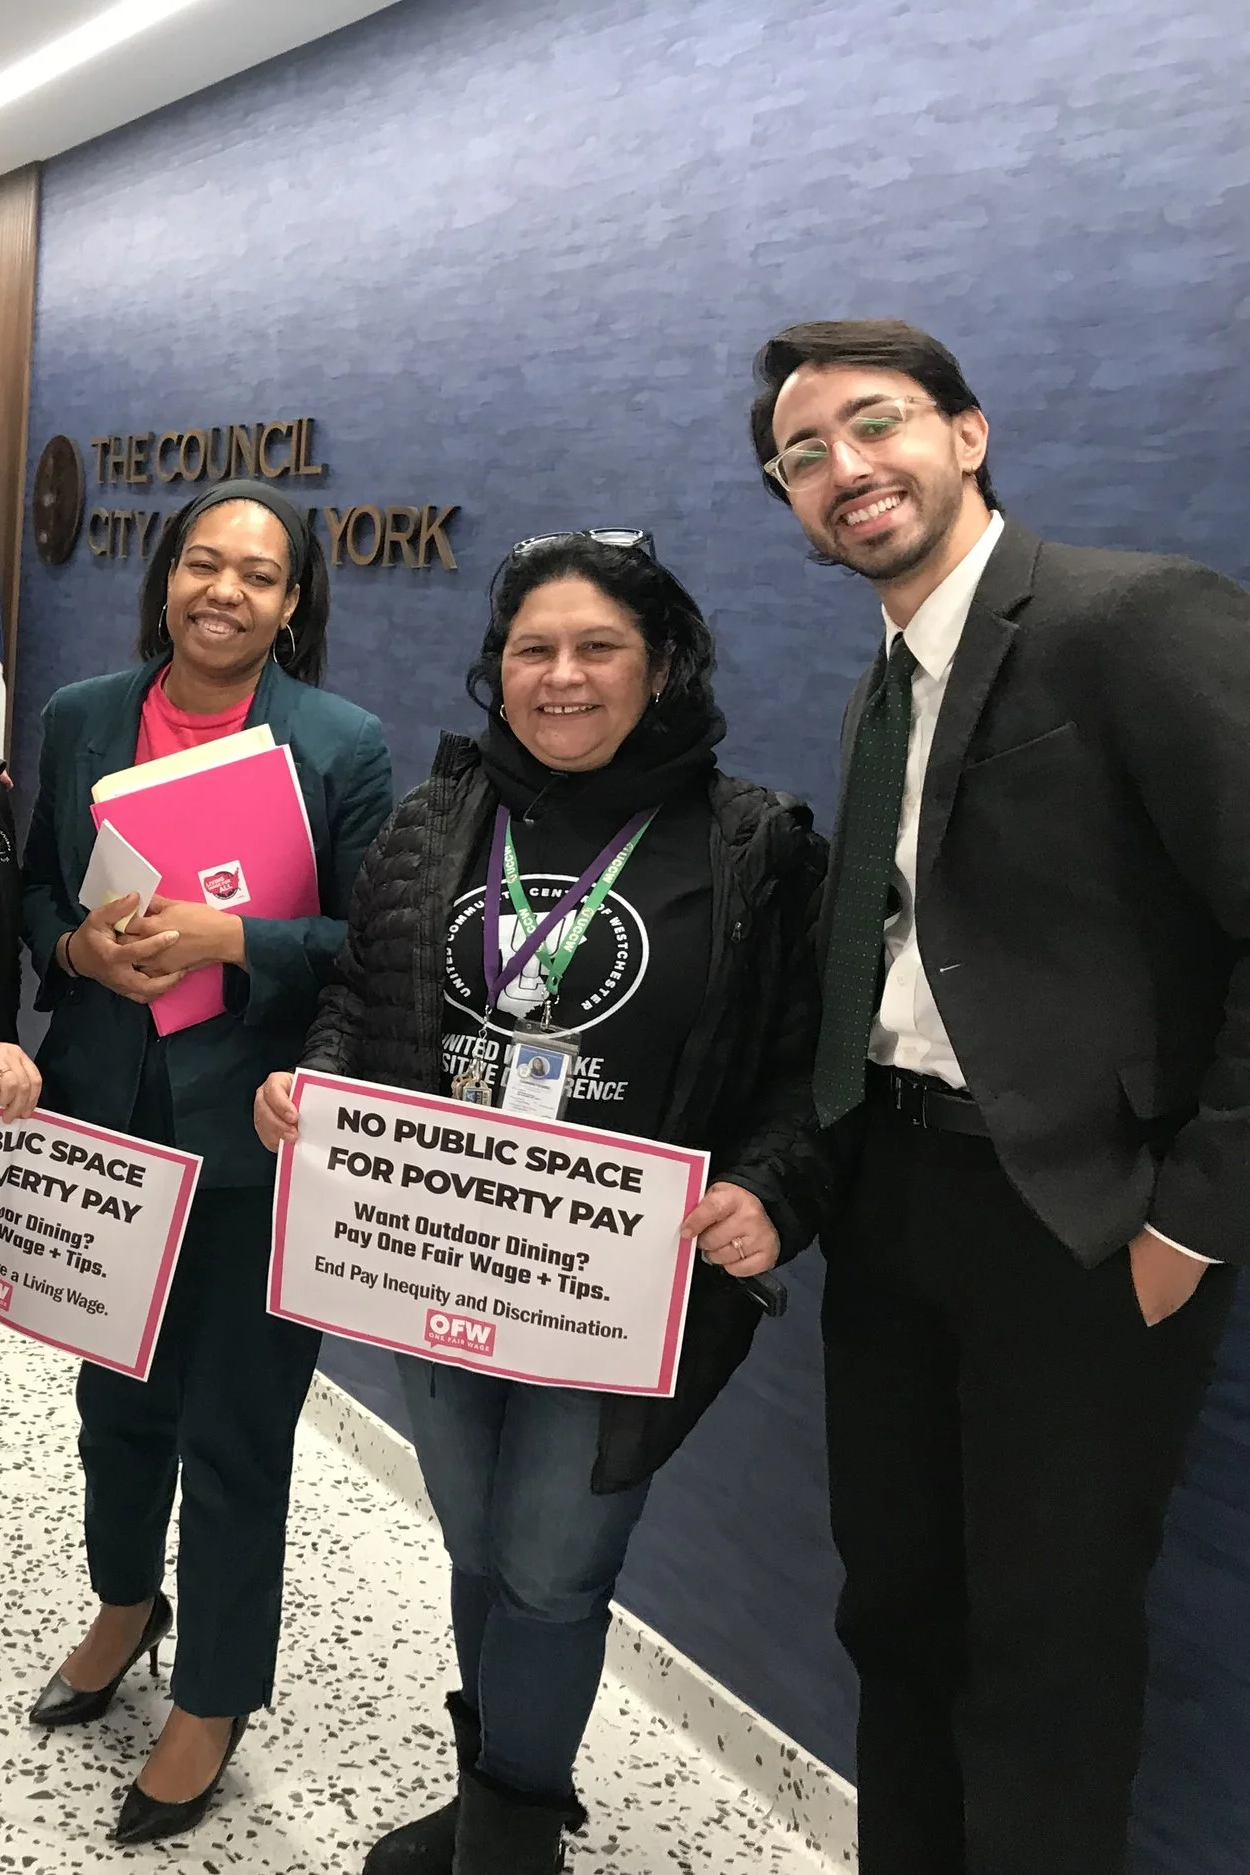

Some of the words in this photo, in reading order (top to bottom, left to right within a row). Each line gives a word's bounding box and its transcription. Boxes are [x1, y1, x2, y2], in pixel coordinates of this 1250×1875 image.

[90, 434, 151, 484] THE
[155, 417, 326, 484] COUNCIL
[86, 508, 153, 560] CITY
[324, 504, 459, 571] YORK
[580, 917, 629, 1011] WESTCHESTER
[49, 1139, 147, 1189] SPACE
[337, 1106, 386, 1138] NO
[394, 1118, 519, 1166] PUBLIC
[524, 1146, 644, 1194] SPACE
[81, 1187, 143, 1225] PAY
[327, 1146, 395, 1184] FOR
[400, 1163, 564, 1219] POVERTY
[569, 1199, 645, 1238] PAY
[25, 1213, 95, 1250] Dining?
[49, 1247, 62, 1259] +
[66, 1249, 108, 1278] Tips.
[333, 1220, 372, 1250] Pay
[377, 1232, 417, 1258] One
[421, 1243, 464, 1269] Fair
[469, 1252, 532, 1286] Wage
[536, 1272, 552, 1286] +
[557, 1272, 611, 1302] Tips.
[354, 1202, 410, 1231] Want
[415, 1216, 501, 1251] Outdoor
[505, 1236, 590, 1273] Dining?
[10, 1271, 20, 1283] a
[22, 1272, 64, 1303] Living
[66, 1290, 109, 1316] Wage.
[314, 1255, 345, 1279] End
[350, 1264, 379, 1289] Pay
[382, 1273, 451, 1307] Inequity
[455, 1290, 488, 1313] and
[493, 1299, 629, 1341] Discrimination.
[428, 1332, 445, 1342] ONE
[447, 1337, 465, 1345] FAIR
[467, 1341, 490, 1352] WAGE
[430, 1314, 491, 1344] OFW
